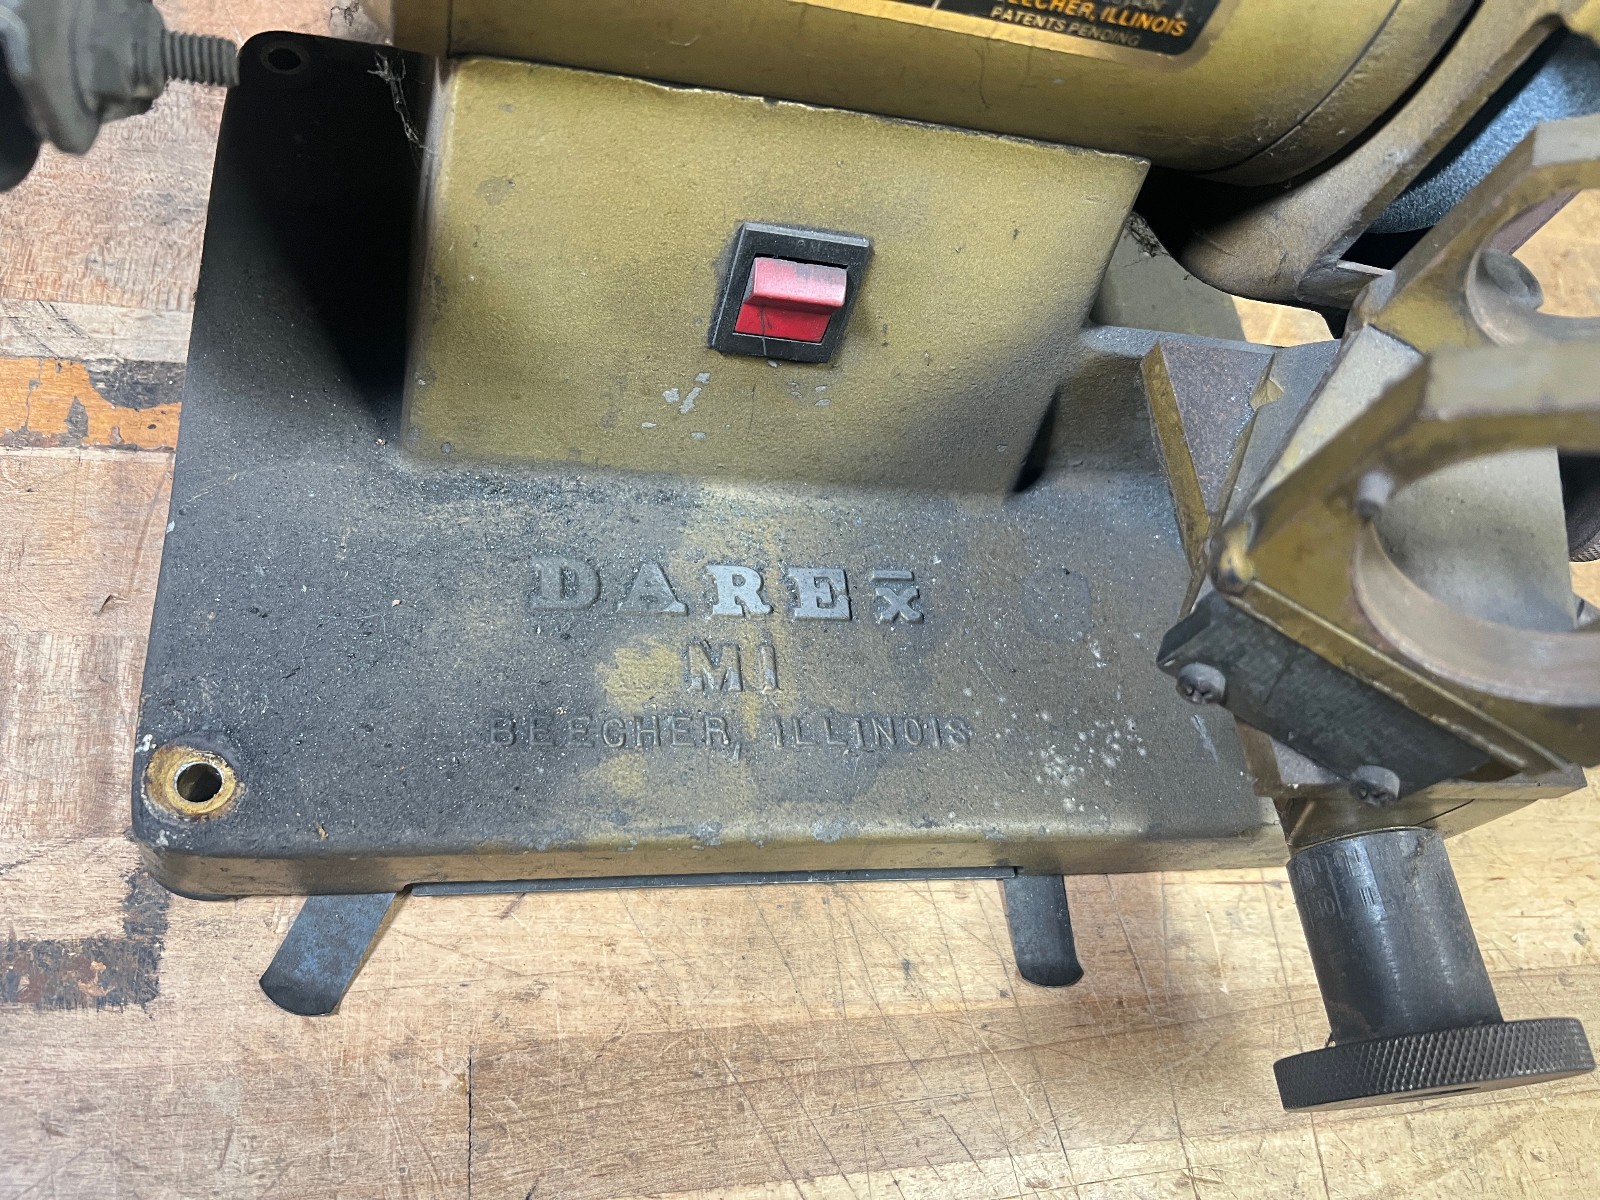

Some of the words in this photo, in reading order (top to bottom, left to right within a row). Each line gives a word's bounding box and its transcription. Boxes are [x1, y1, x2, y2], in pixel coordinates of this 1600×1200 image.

[990, 6, 1066, 31] PATENTS
[1066, 21, 1142, 47] PENDING
[1099, 6, 1188, 36] ILLINOIS
[771, 713, 973, 750] ILLINOIS
